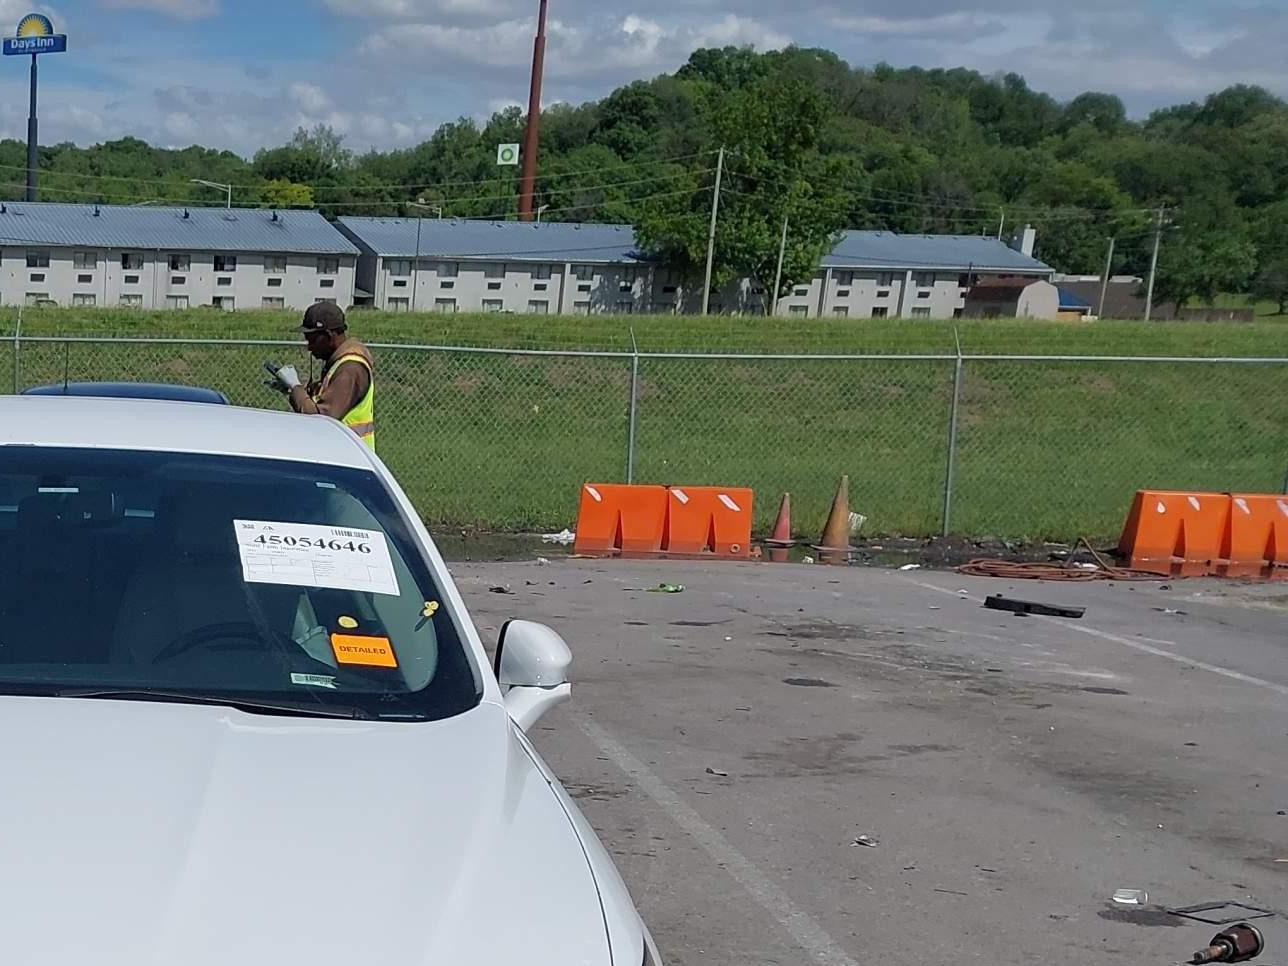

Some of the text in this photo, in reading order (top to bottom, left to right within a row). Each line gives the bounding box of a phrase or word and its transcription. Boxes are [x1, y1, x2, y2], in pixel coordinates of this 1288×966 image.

[11, 37, 54, 50] Days Inn
[254, 534, 372, 554] 45054646
[338, 645, 387, 655] DETAILED
